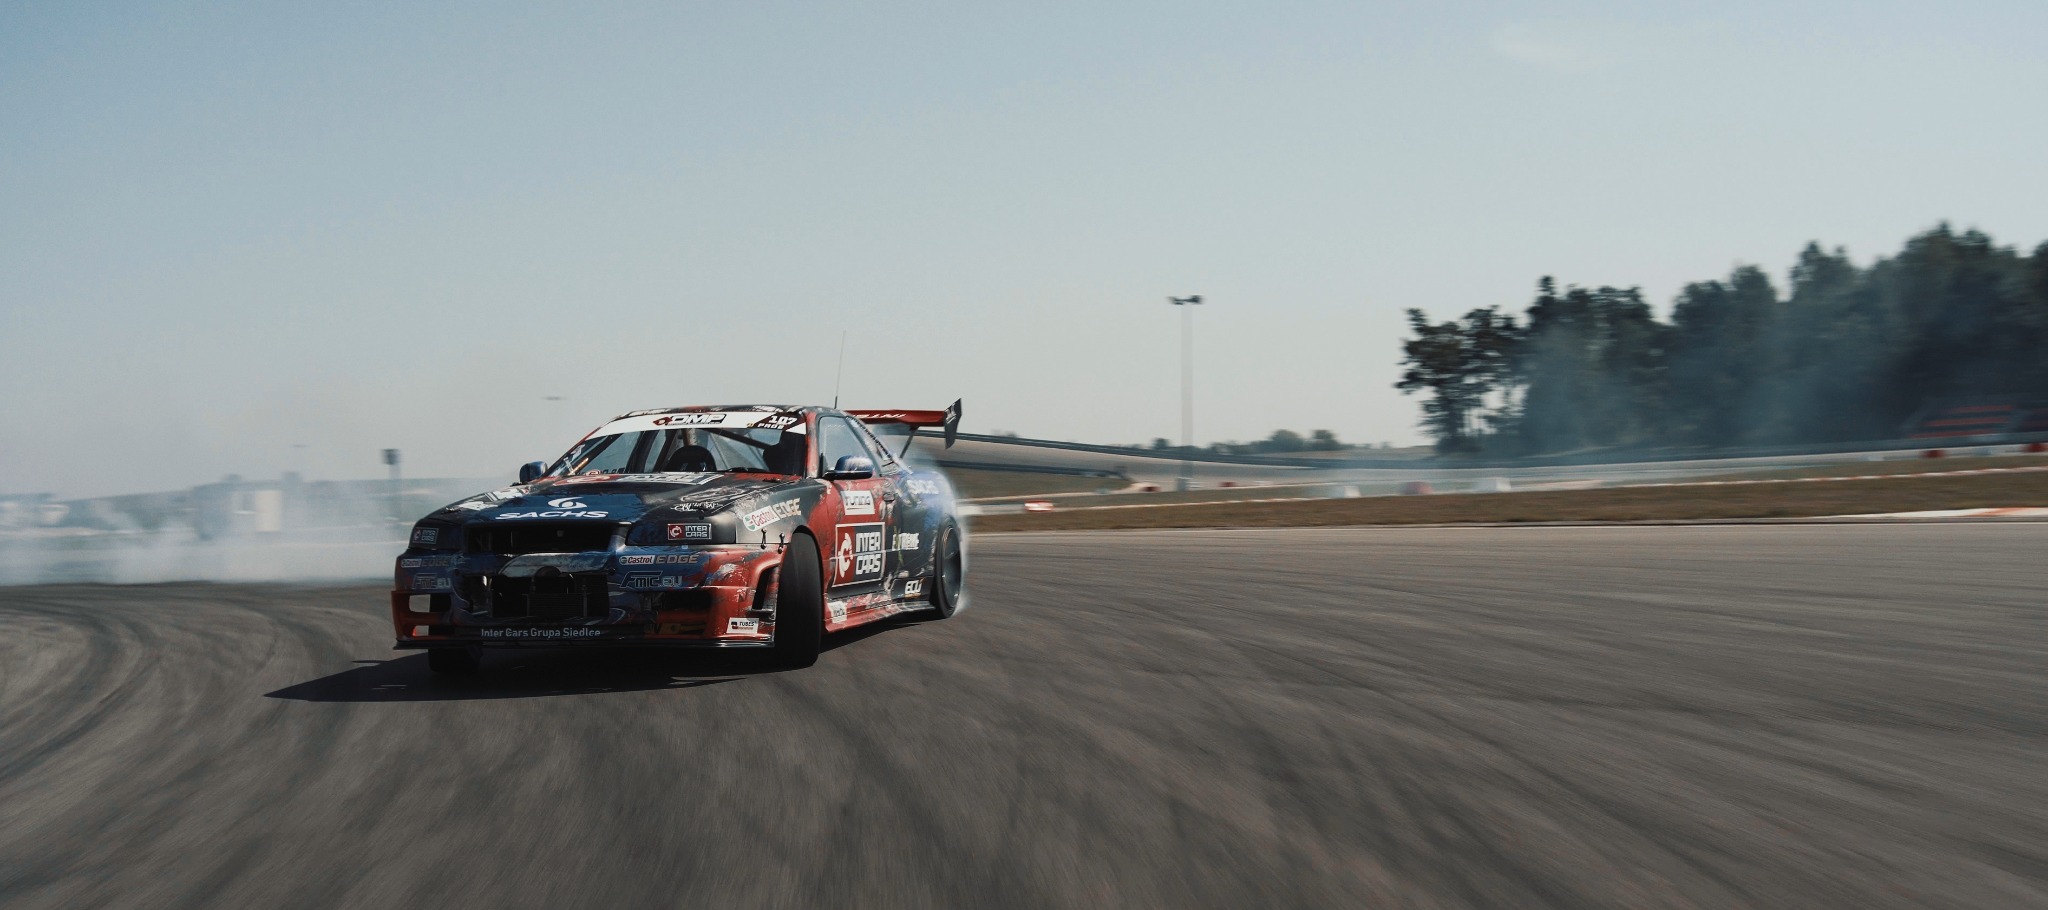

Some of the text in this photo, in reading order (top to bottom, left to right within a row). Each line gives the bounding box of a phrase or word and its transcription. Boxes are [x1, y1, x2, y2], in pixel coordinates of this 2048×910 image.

[768, 415, 798, 426] 107
[772, 497, 802, 519] EDGE
[495, 510, 609, 520] SACHS
[855, 531, 882, 553] INTER
[627, 554, 699, 564] Castrol EDGE
[855, 553, 882, 575] CARS
[481, 628, 600, 639] Inter Cars Grupa Siedlce
